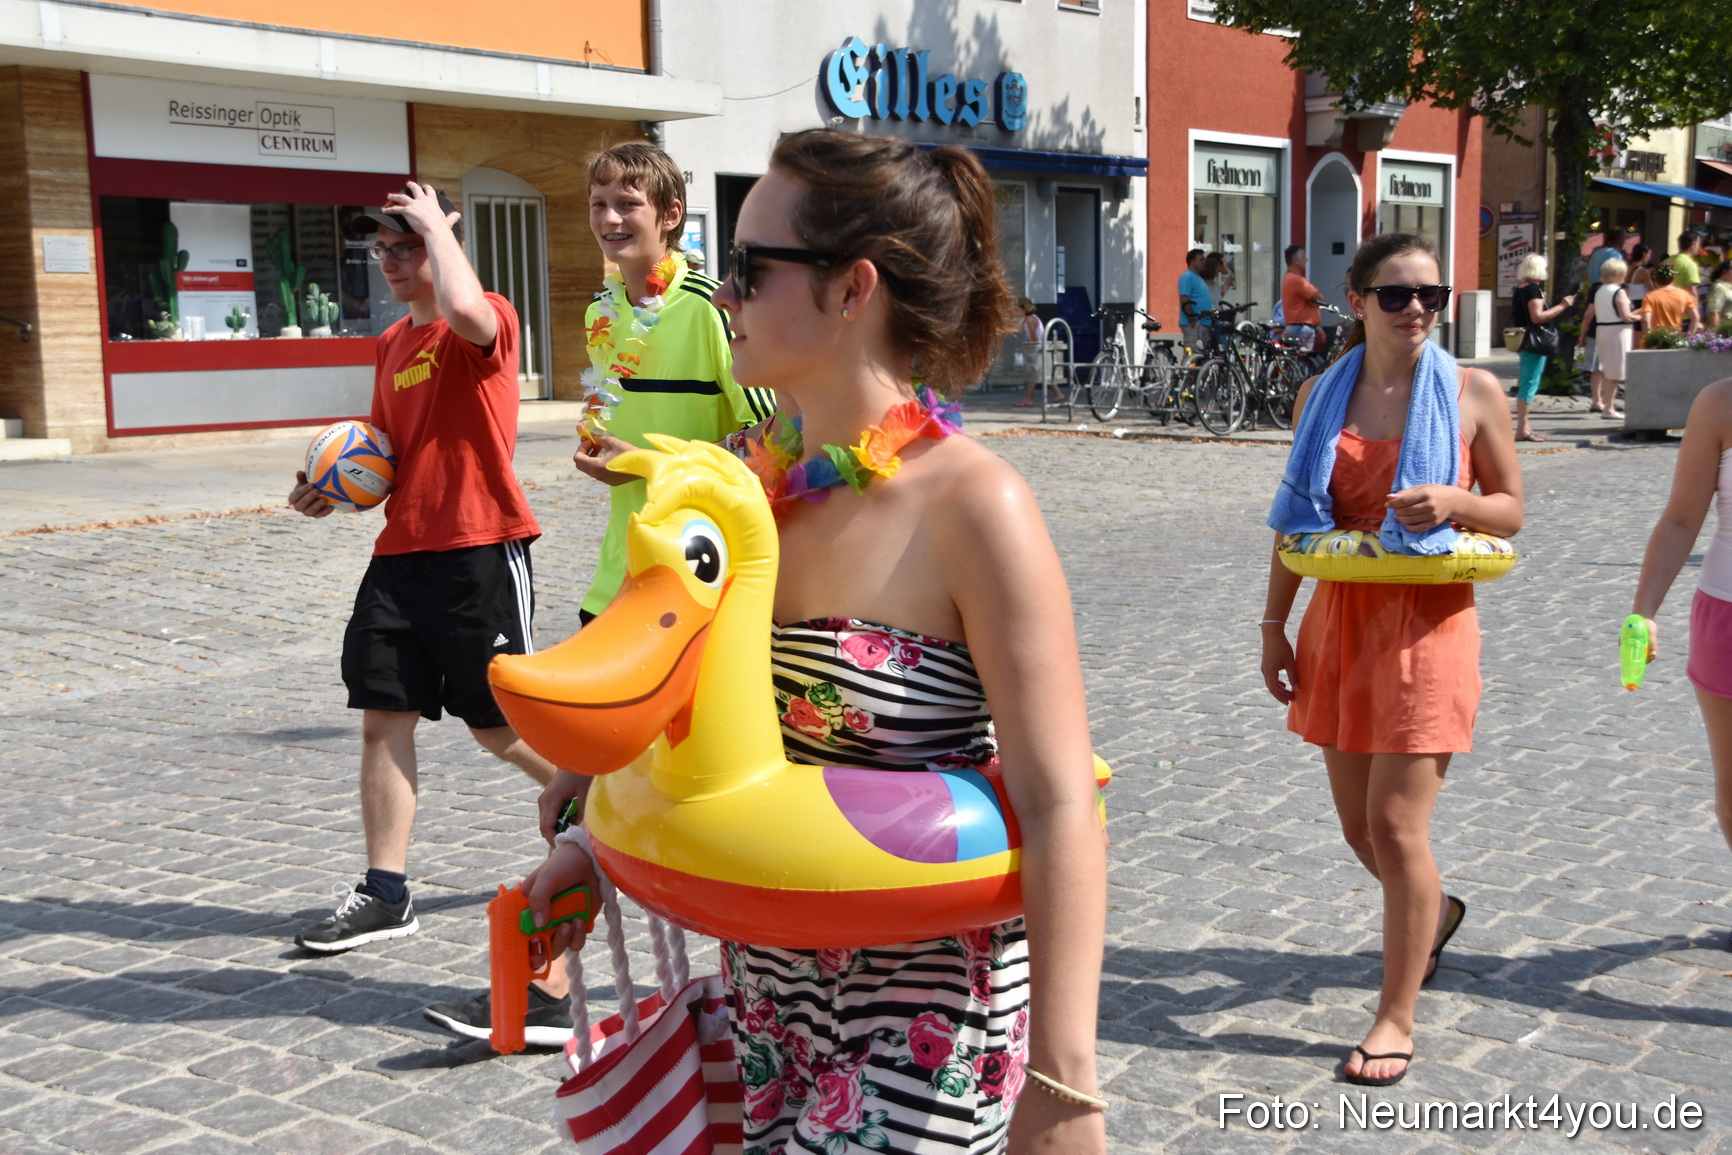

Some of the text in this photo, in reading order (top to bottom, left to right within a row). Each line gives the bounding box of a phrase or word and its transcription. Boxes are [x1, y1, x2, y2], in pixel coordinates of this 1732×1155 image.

[821, 36, 989, 128] Eilles
[169, 100, 301, 128] Reissinger Optik
[261, 135, 334, 153] CENTRUM
[1207, 158, 1262, 187] fielmann
[1389, 173, 1432, 198] fielmann
[394, 361, 432, 391] PUMA
